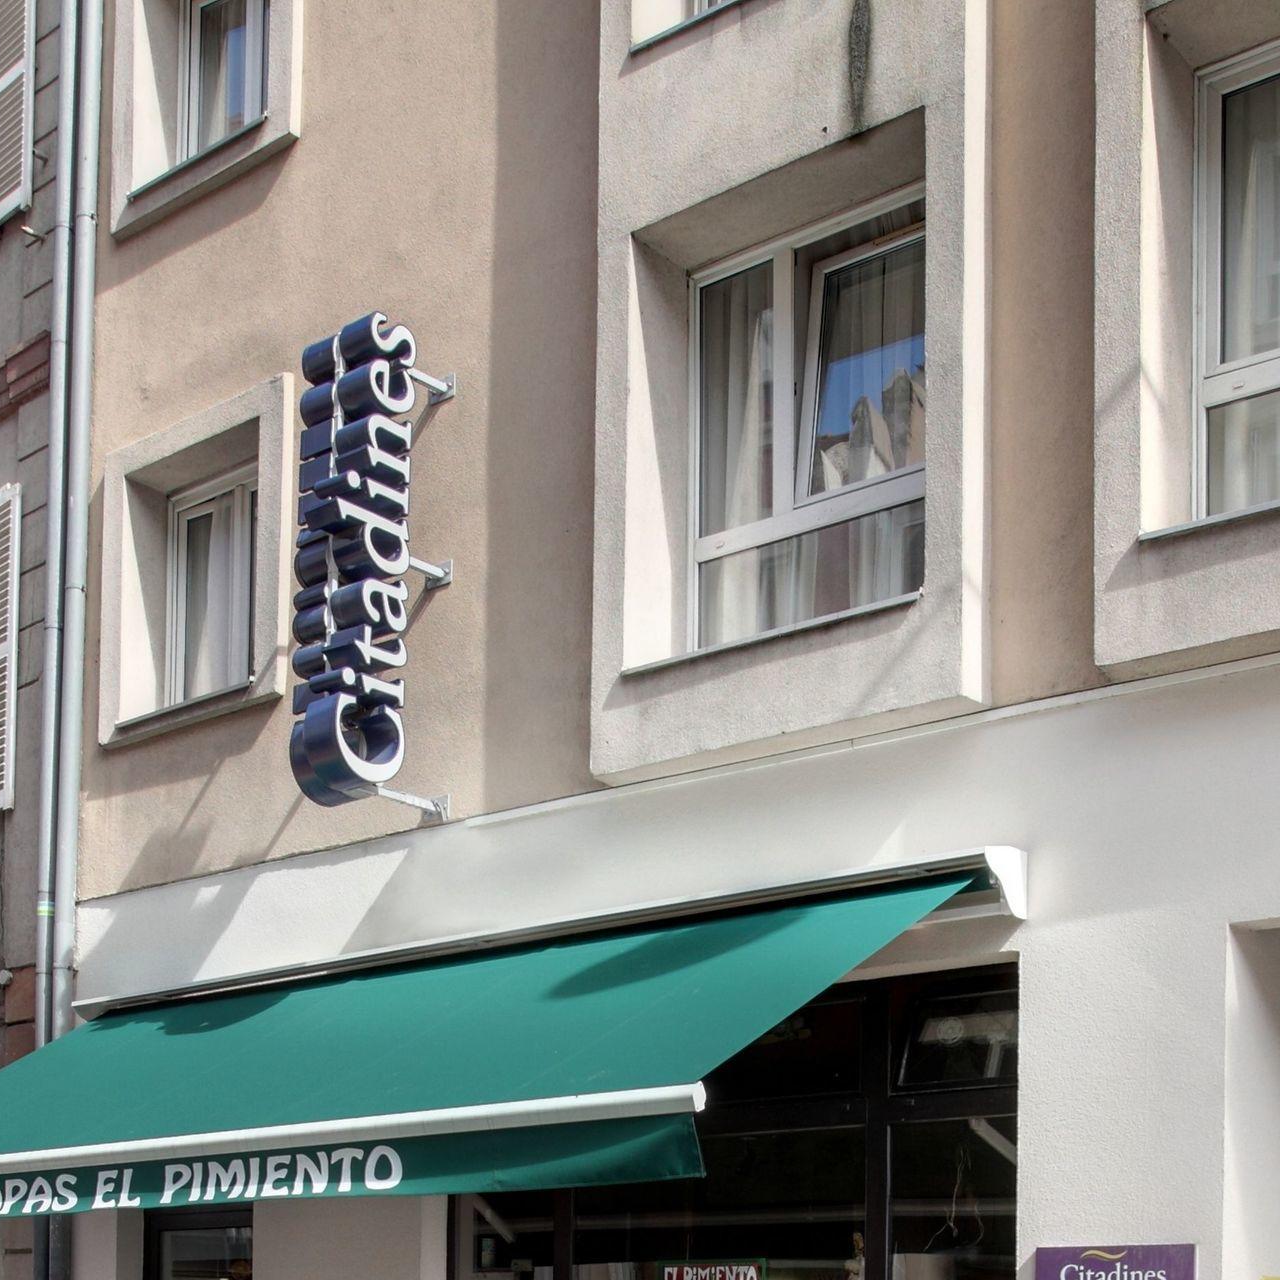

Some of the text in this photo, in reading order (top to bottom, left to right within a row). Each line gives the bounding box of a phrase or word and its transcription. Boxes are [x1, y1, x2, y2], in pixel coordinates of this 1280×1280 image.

[332, 310, 417, 785] Citadines
[92, 1167, 141, 1210] EL
[160, 1144, 404, 1205] PIMIENTO
